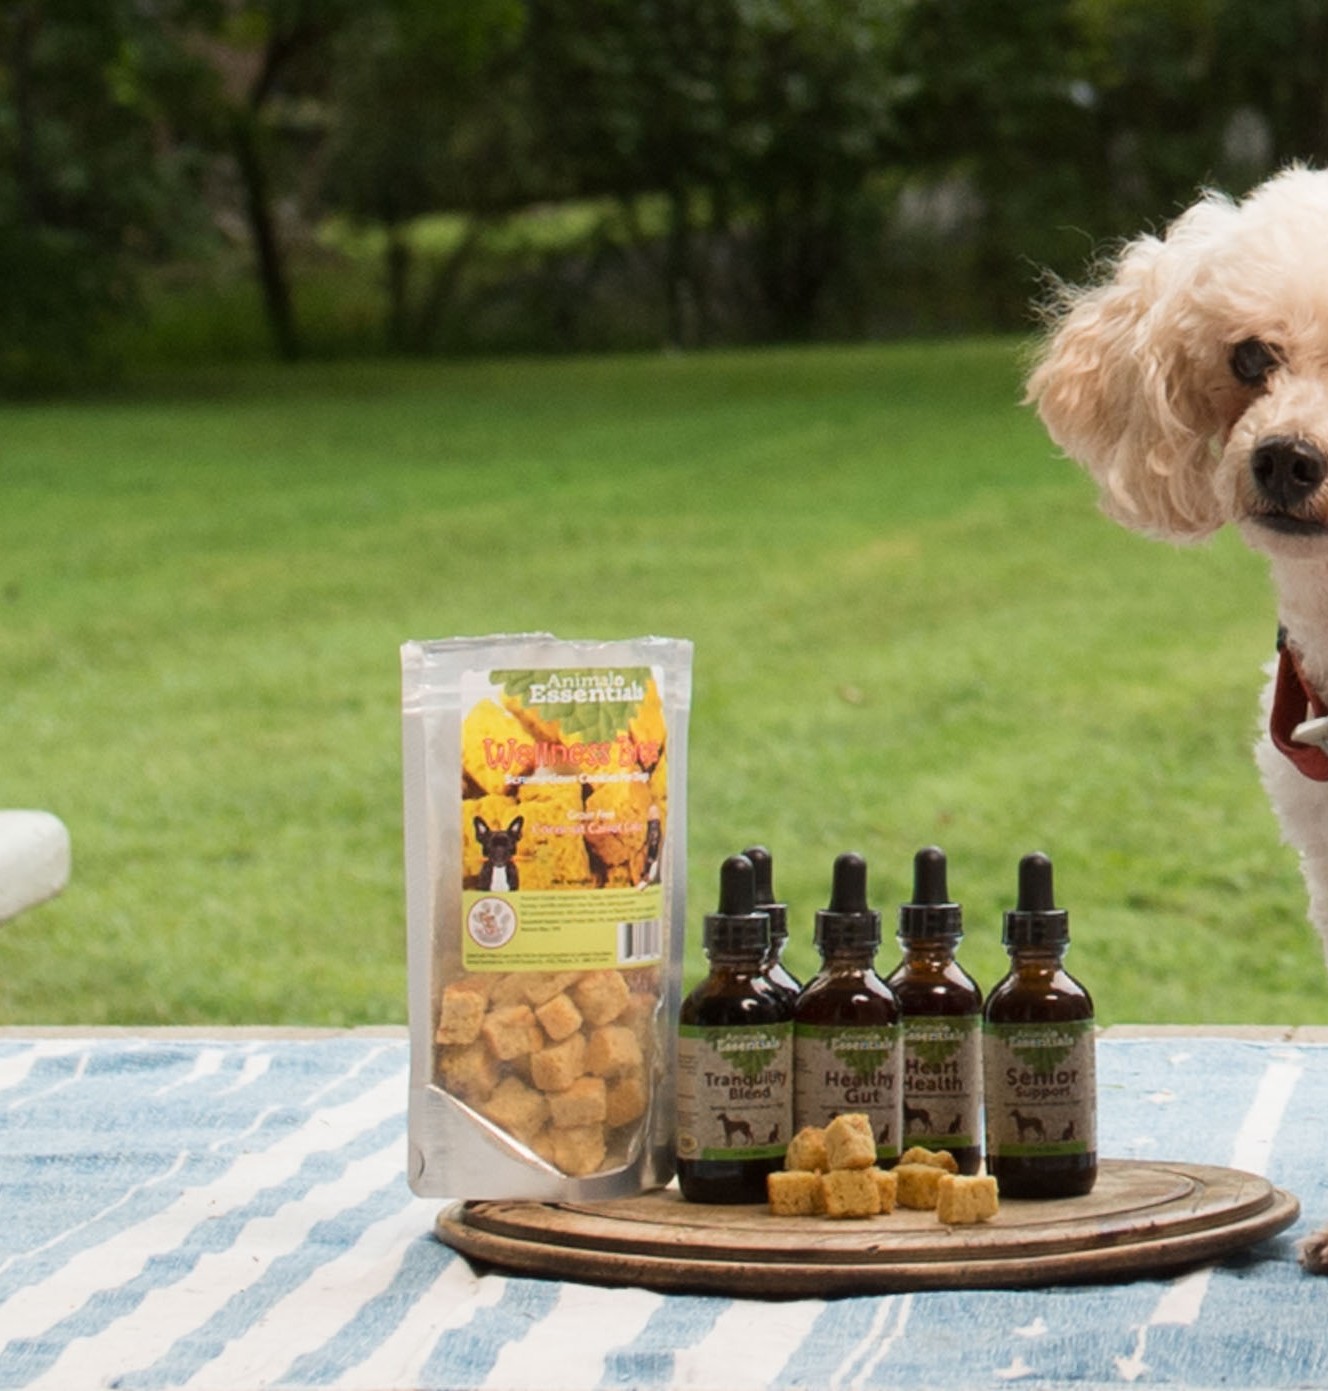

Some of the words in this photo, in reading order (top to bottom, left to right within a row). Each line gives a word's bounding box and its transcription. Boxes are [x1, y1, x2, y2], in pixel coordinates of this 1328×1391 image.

[483, 738, 611, 770] Wellness
[905, 1058, 958, 1074] Heart
[704, 1070, 787, 1088] Tranquility
[825, 1070, 894, 1090] Healthy
[1006, 1067, 1079, 1086] Senior
[729, 1086, 772, 1100] Blend
[845, 1088, 880, 1104] Gut
[1015, 1086, 1070, 1099] Support
